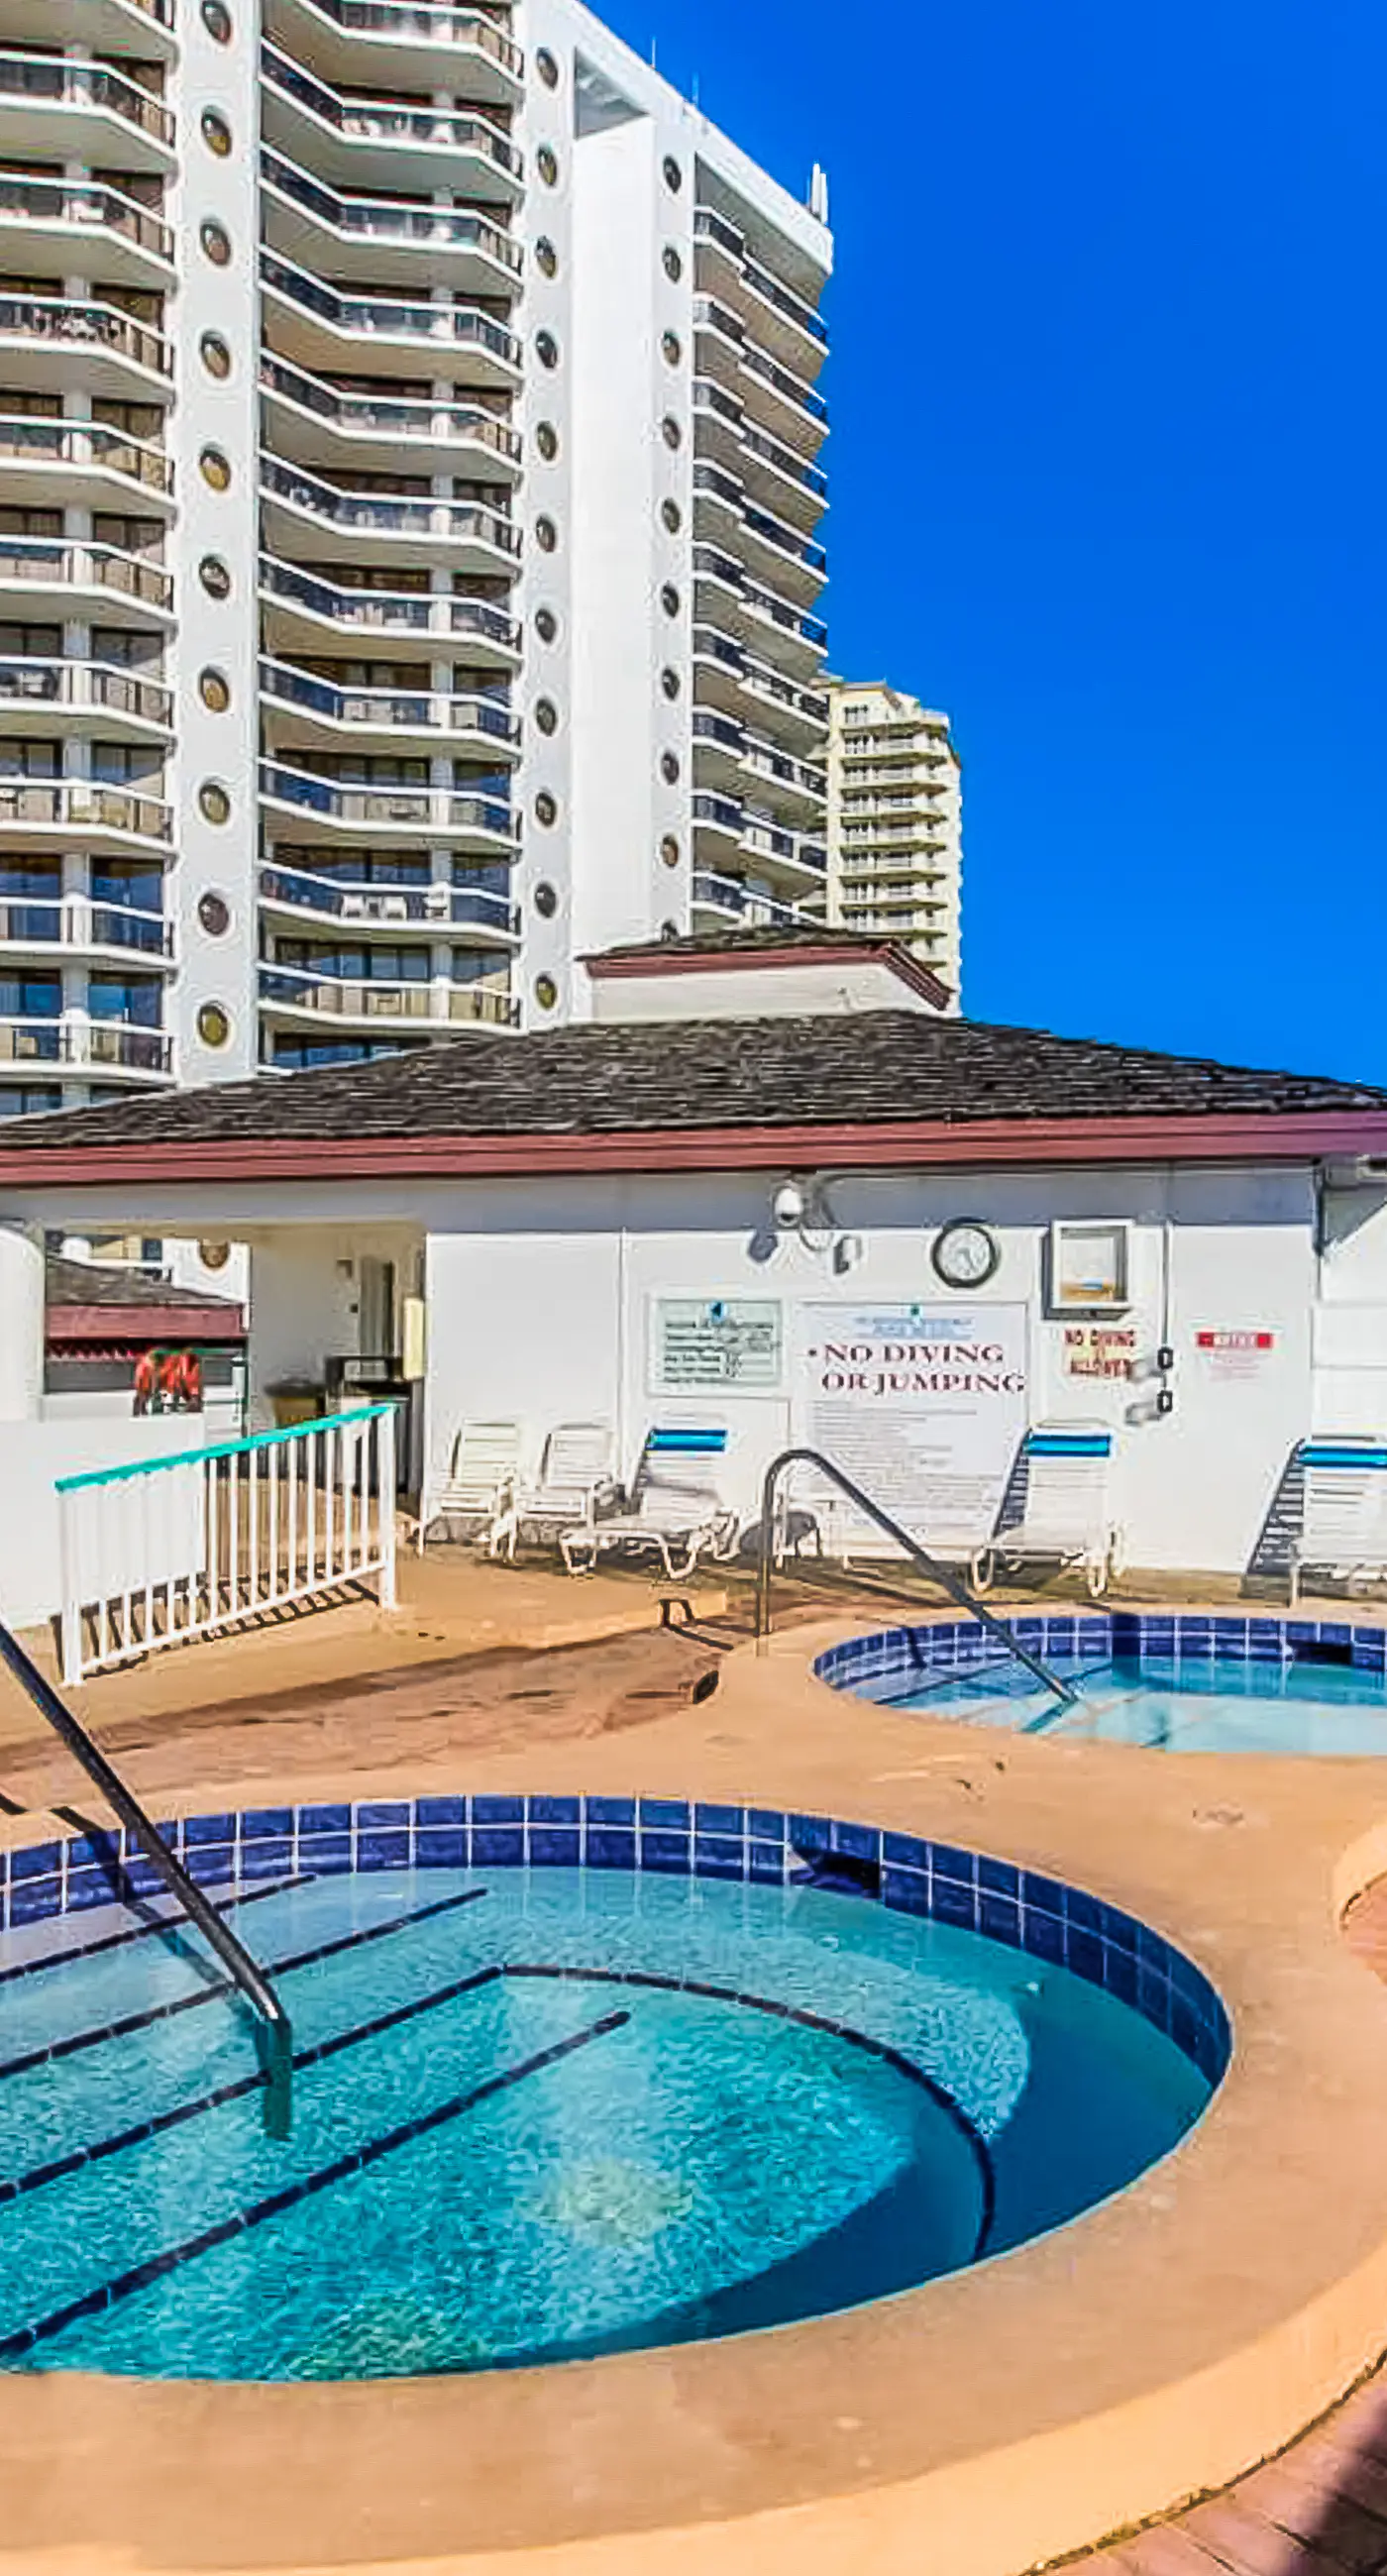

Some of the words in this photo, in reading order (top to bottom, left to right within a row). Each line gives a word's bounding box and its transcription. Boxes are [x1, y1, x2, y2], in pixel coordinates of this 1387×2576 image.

[1064, 1329, 1084, 1346] NO
[823, 1343, 873, 1362] NO
[884, 1343, 1004, 1362] DIVING
[821, 1372, 869, 1391] OR
[874, 1372, 1025, 1395] JUMPING
